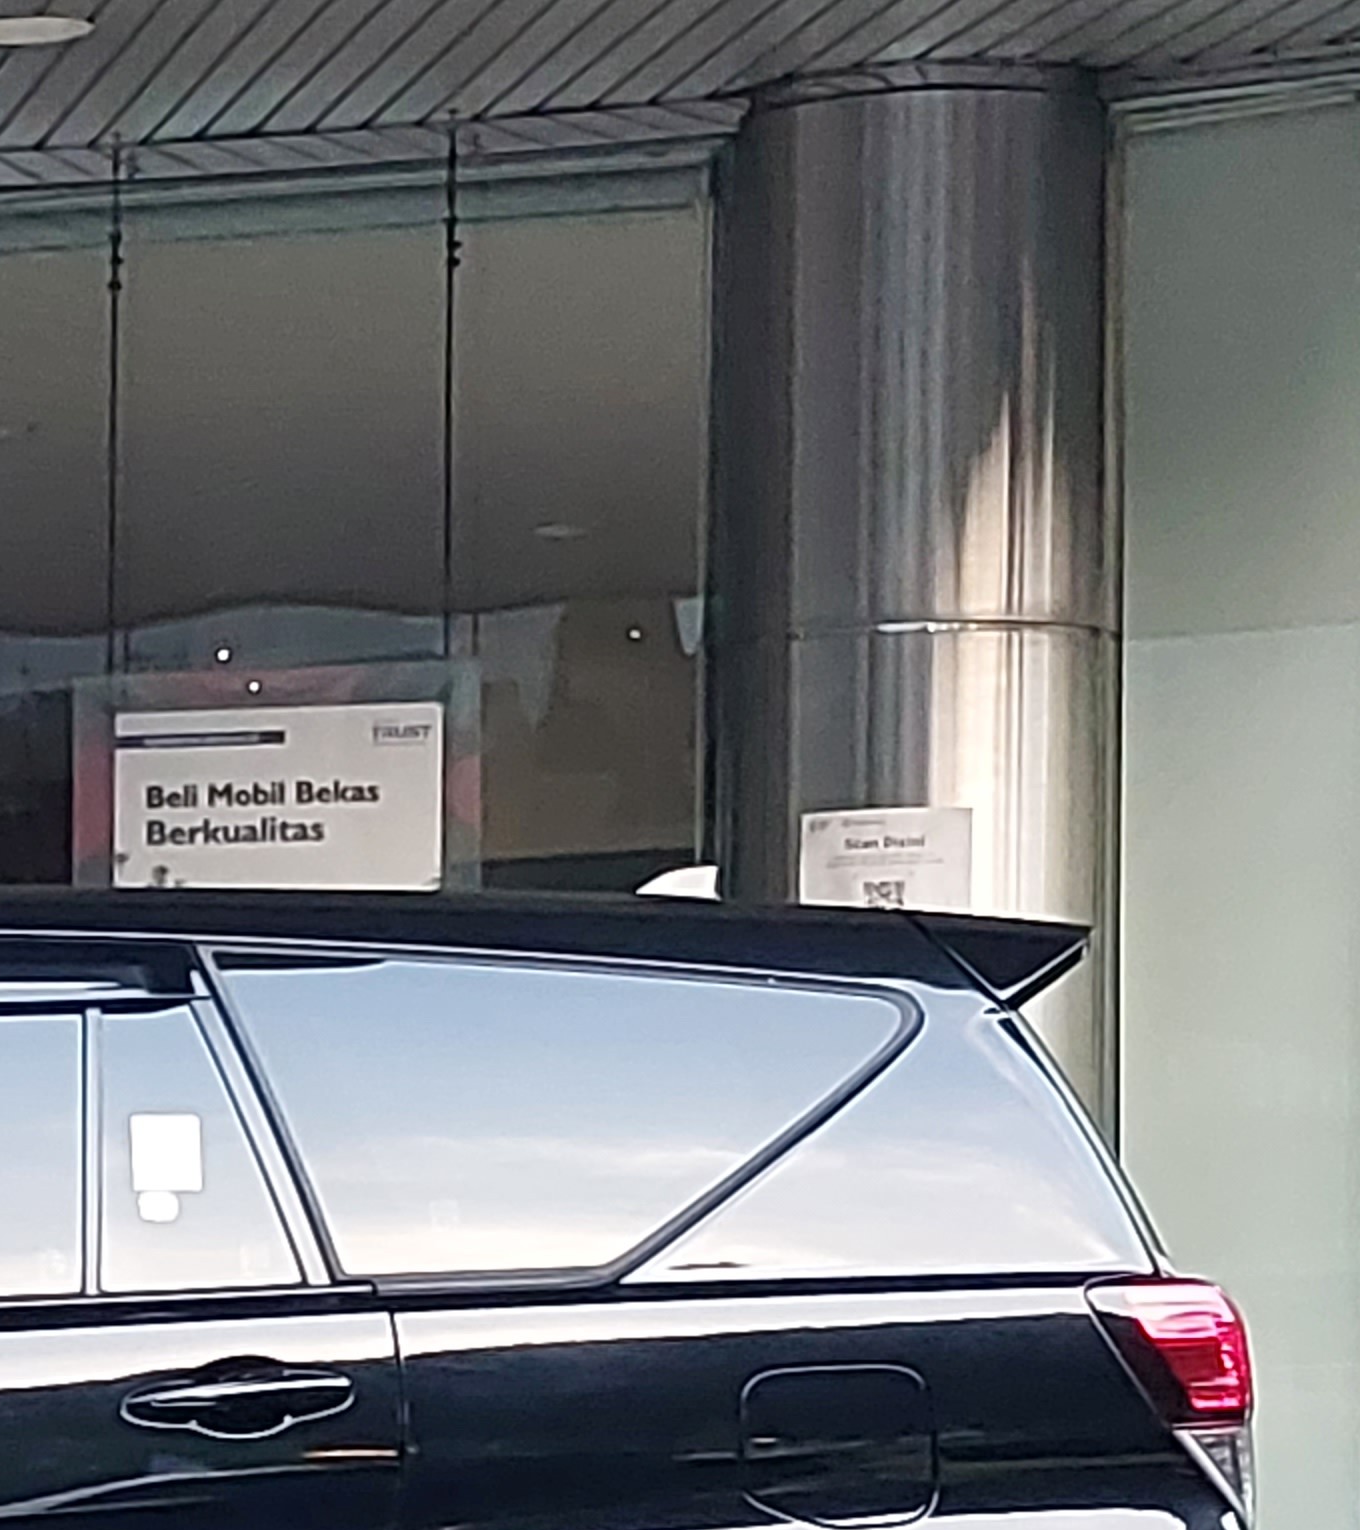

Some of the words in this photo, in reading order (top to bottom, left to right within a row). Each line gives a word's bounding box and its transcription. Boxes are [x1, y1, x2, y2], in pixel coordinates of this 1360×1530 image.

[373, 722, 432, 739] TRUST
[145, 784, 198, 809] Beli
[208, 781, 286, 807] Mobil
[295, 780, 380, 804] Bekas
[145, 817, 325, 846] Berkualitas
